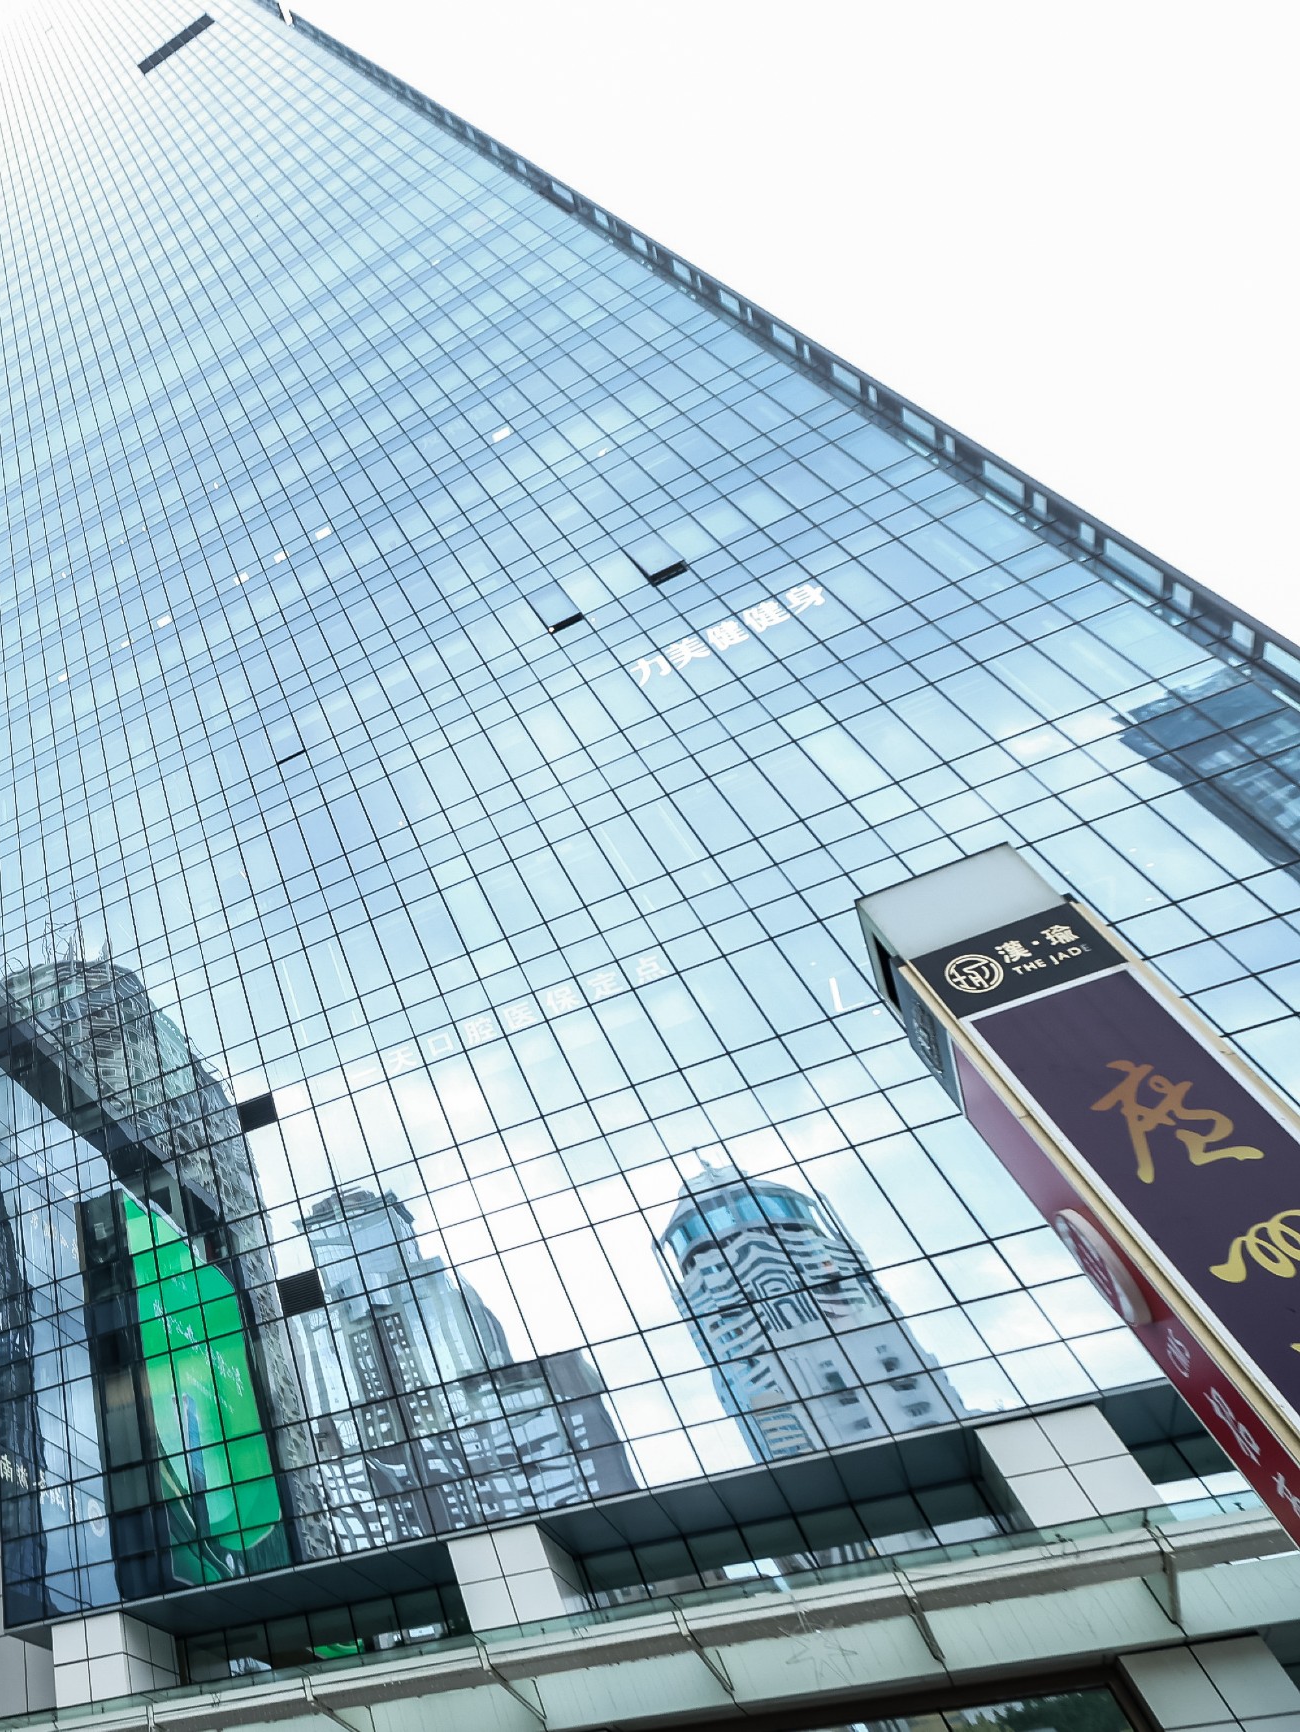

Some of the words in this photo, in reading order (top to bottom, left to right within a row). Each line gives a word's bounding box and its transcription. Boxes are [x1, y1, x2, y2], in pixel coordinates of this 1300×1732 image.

[630, 584, 825, 687] 力美健健身
[1012, 957, 1047, 976] THE
[1049, 943, 1091, 966] JADE
[349, 954, 669, 1084] 一天口腔医保定点
